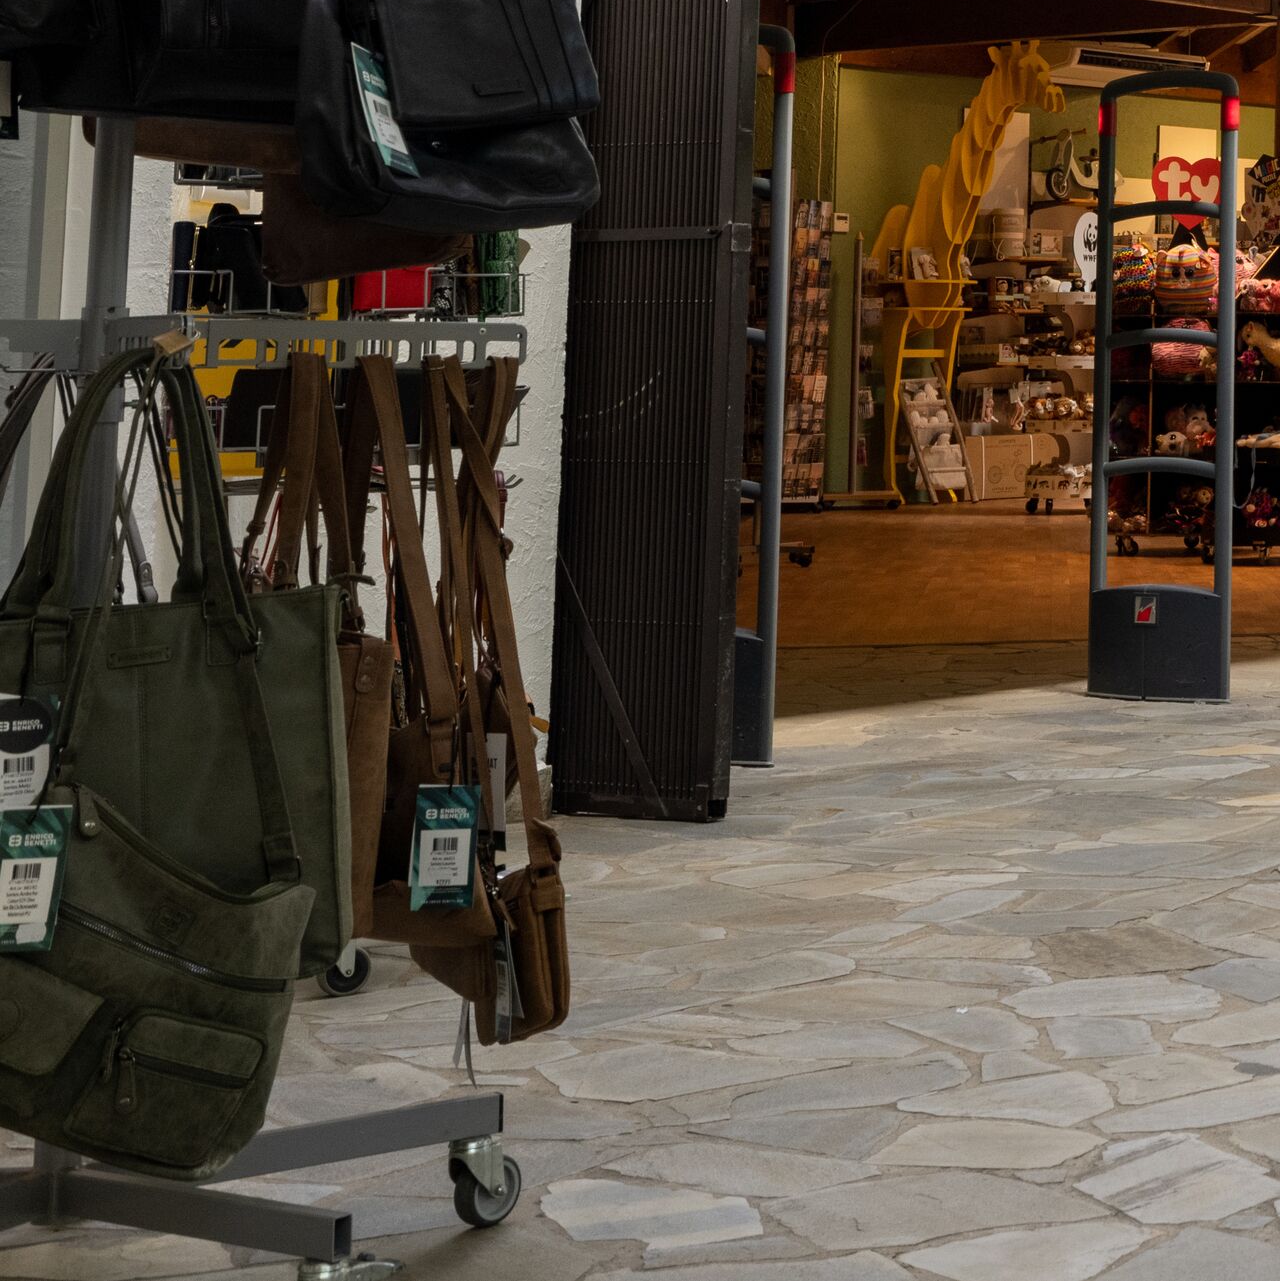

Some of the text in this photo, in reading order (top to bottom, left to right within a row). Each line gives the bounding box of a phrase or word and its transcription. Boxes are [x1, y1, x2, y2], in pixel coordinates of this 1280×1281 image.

[1158, 160, 1219, 202] ty
[12, 719, 41, 727] ENRICO
[12, 723, 44, 731] BENETTI
[440, 807, 468, 815] ENRICO
[440, 812, 470, 820] BENETTI
[25, 833, 54, 841] ENRICO
[24, 838, 57, 847] BENETTI
